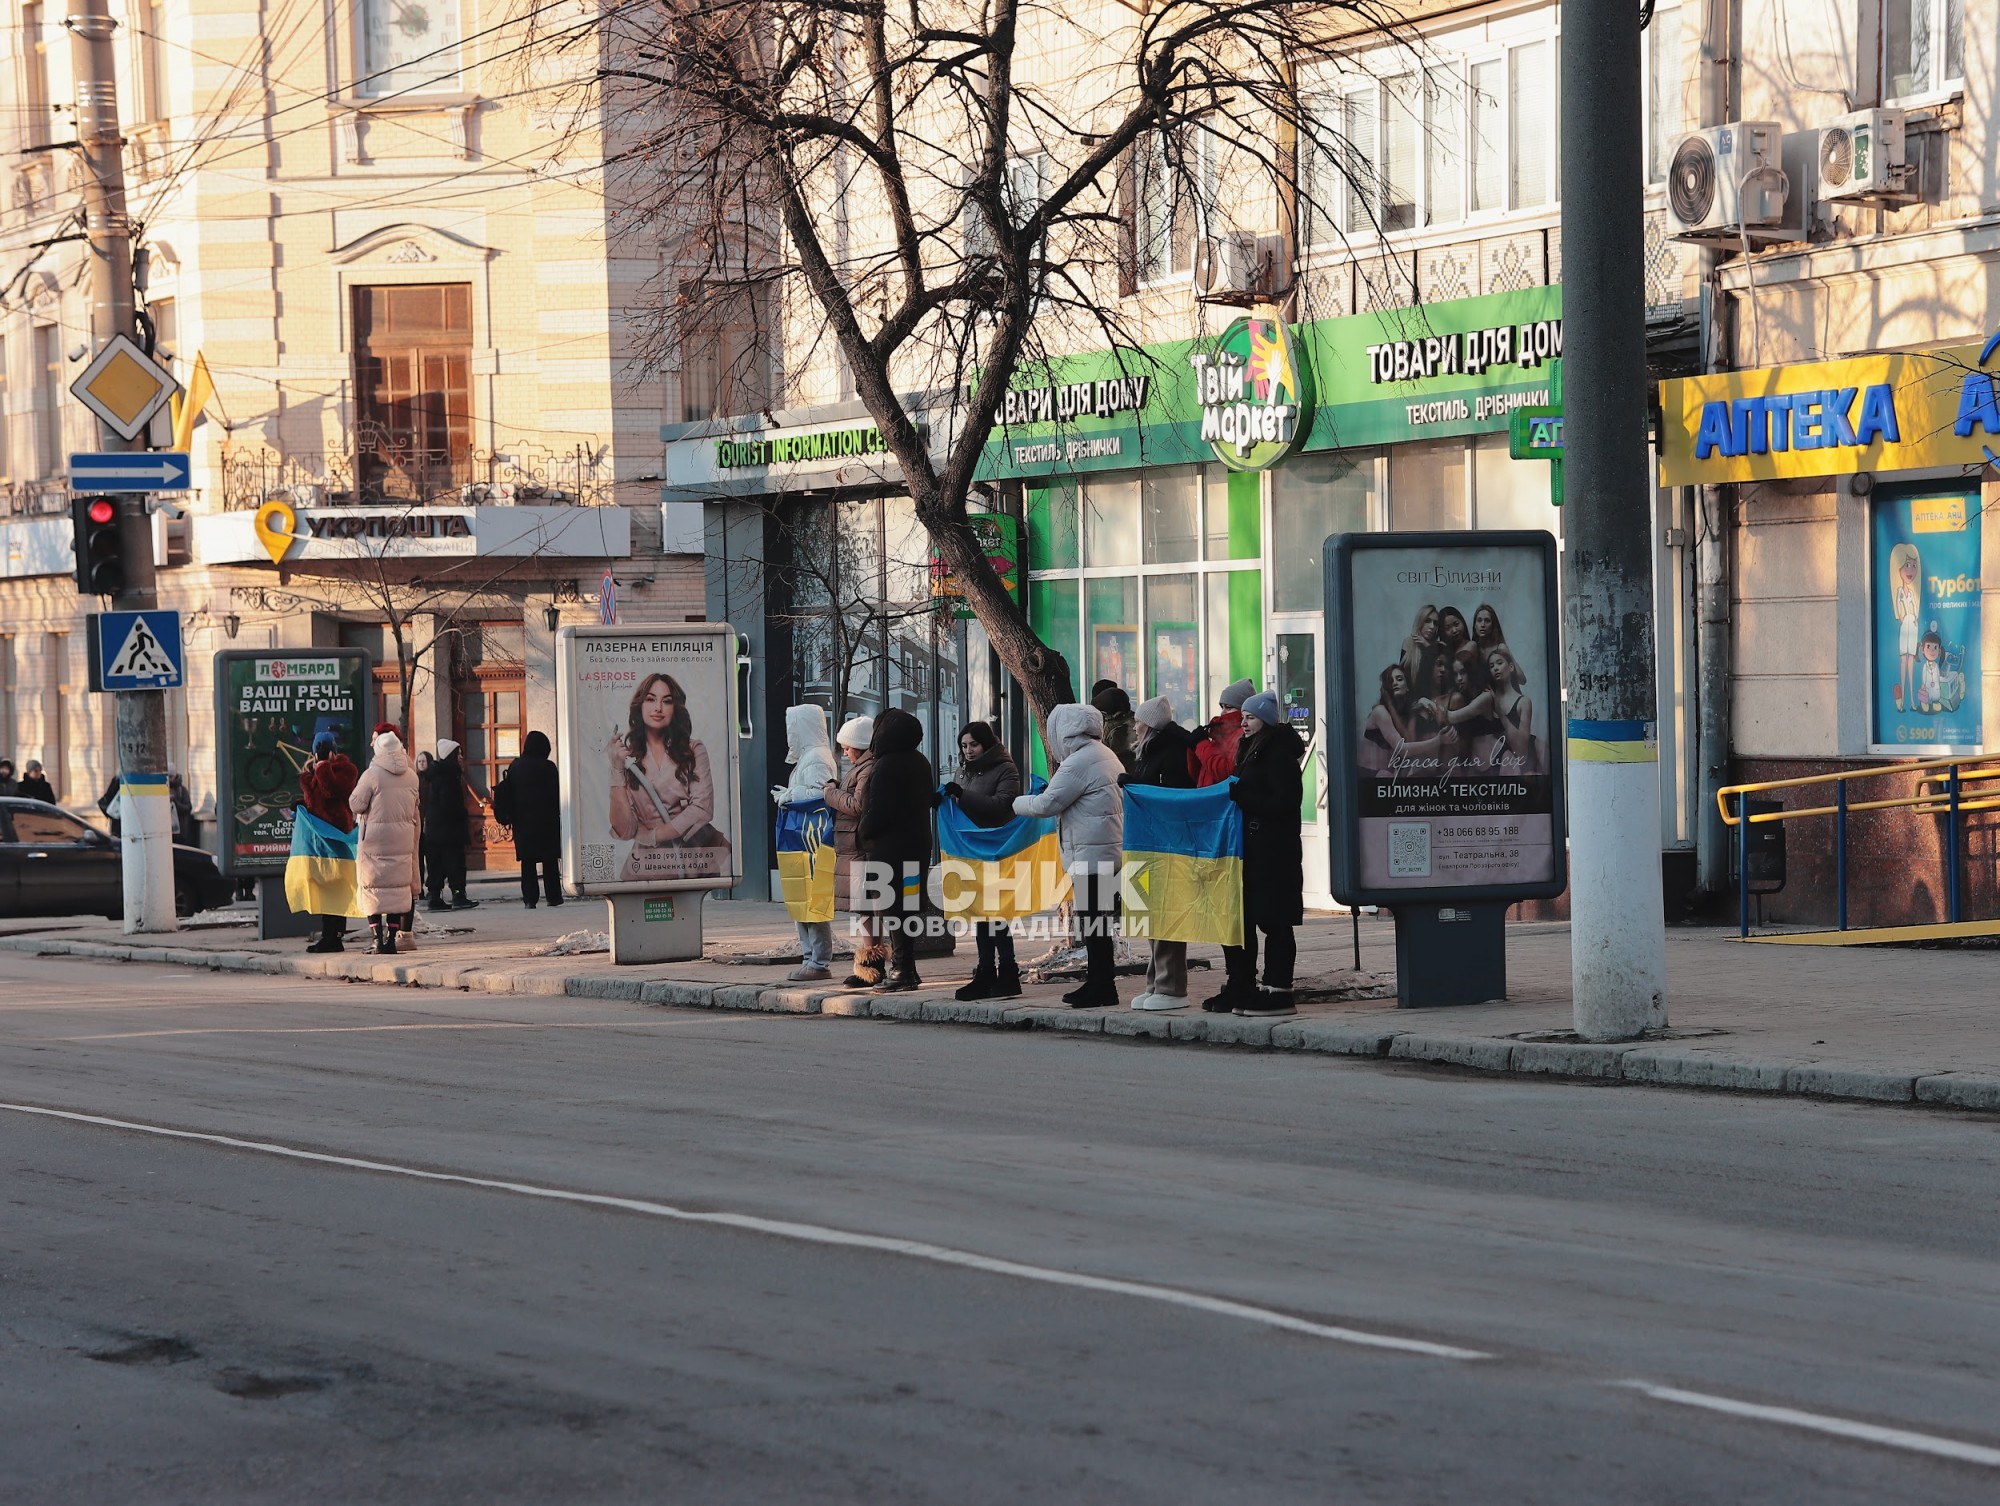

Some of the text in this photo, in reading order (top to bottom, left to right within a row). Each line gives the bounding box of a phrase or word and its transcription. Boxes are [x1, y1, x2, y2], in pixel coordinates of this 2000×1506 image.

[1366, 320, 1564, 383] ТОВАРИ ДЛЯ ДОМ
[1191, 351, 1244, 406] Твій
[994, 376, 1147, 425] ОВАРИ ДЛЯ ДОМУ
[1954, 373, 2000, 437] А
[1406, 398, 1470, 425] ТЕКСТИЛЬ
[1695, 383, 1901, 460] АПТЕКА
[1201, 402, 1288, 457] маркет
[713, 439, 767, 469] TOURIST
[772, 429, 863, 463] INFORMATION
[1014, 437, 1121, 465] ТЕКСТИЛЬ ДРІБНИЧКИ
[1916, 512, 1944, 521] АПТЕКА
[305, 515, 472, 538] УКРПОШТА
[585, 641, 714, 654] ЛАЗЕРНА ЕПІЛЯЦІЯ
[589, 655, 603, 663] Без
[605, 655, 628, 663] болю.
[631, 655, 645, 663] Без
[647, 655, 679, 663] зайвого
[260, 660, 336, 679] ЛОМБАРД
[578, 671, 636, 681] LASEROSE
[242, 685, 290, 699] ВАШІ
[240, 698, 353, 713] ВАШІ ГРОШІ
[1909, 728, 1936, 740] 5900
[1387, 735, 1528, 789] краса для всіх
[1377, 783, 1528, 798] БІЛИЗНА ТЕКСТИЛЬ
[1395, 802, 1510, 813] для жінок та чоловіків
[277, 820, 296, 828] Гого
[1437, 826, 1519, 838] +38 066 68 95 188
[253, 843, 292, 852] ПРИЙМА
[1453, 850, 1508, 860] Театральна,
[1509, 850, 1519, 858] 38
[644, 852, 661, 860] +380
[663, 852, 678, 861] (99)
